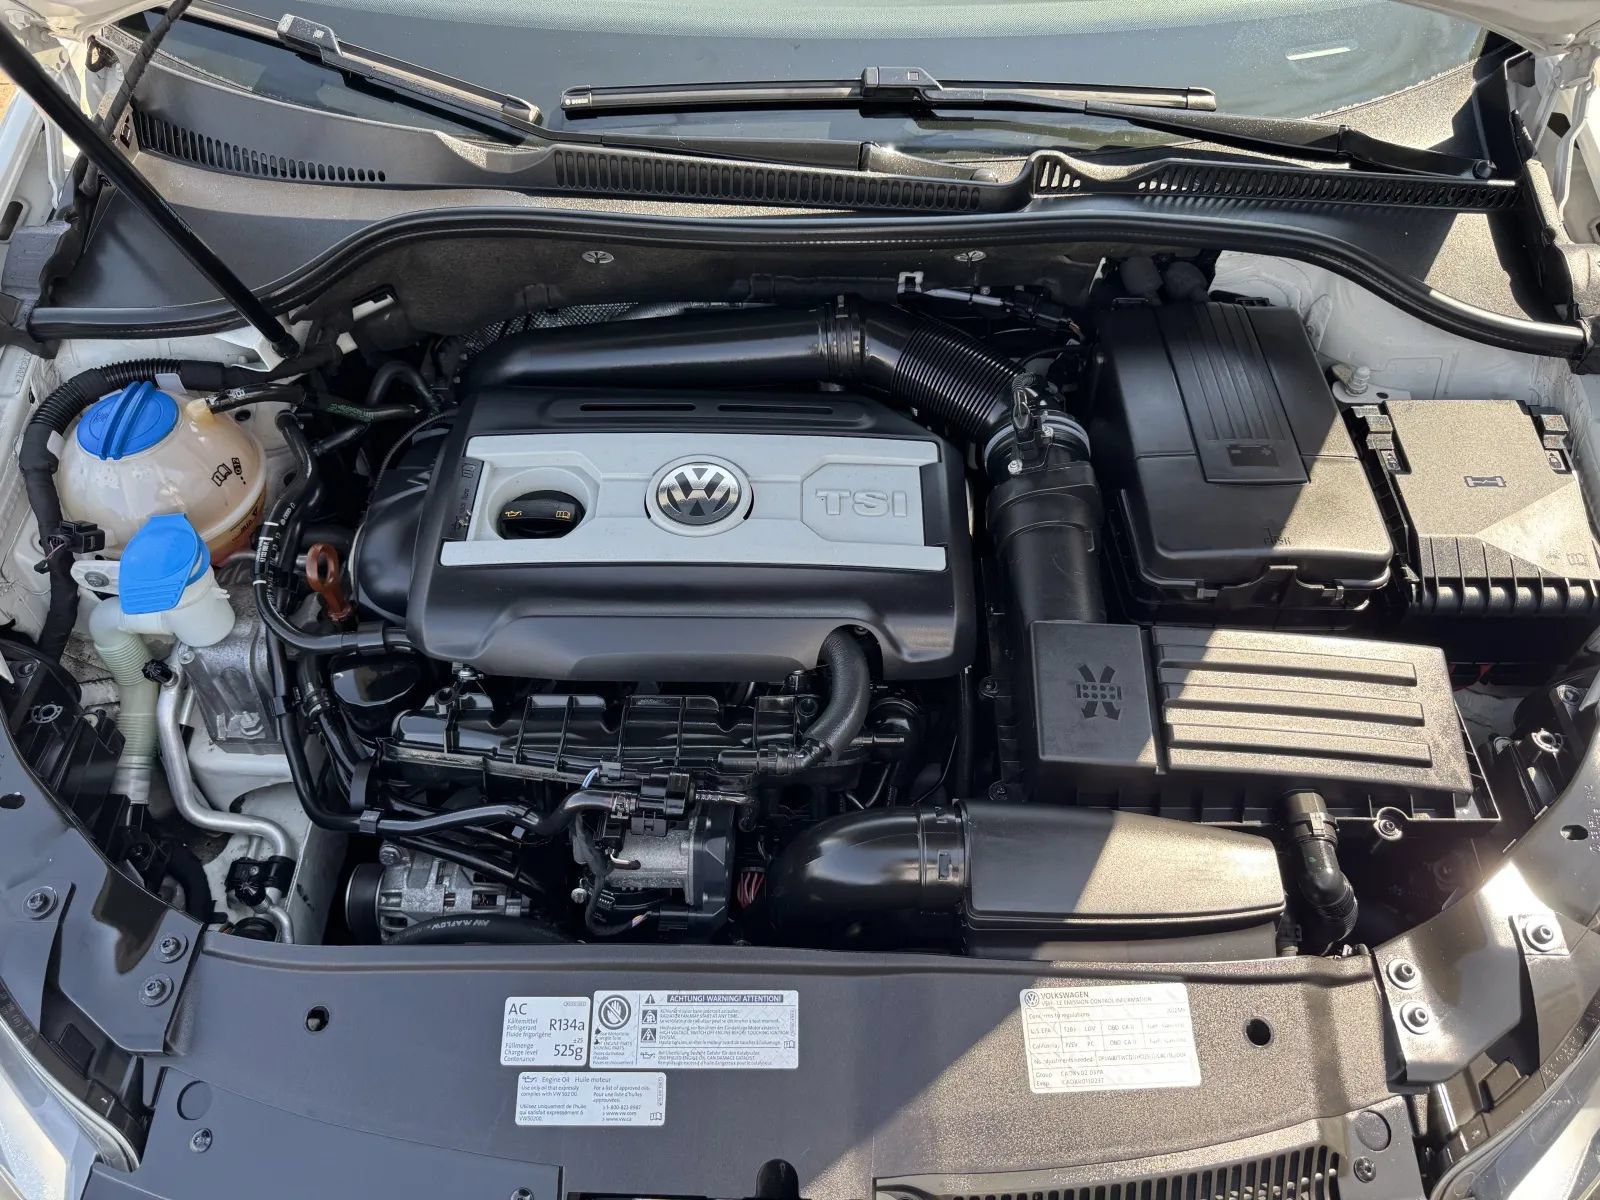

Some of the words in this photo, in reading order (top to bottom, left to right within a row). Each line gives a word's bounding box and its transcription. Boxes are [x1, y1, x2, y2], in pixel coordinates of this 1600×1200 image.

[815, 488, 908, 519] TSI
[1040, 991, 1089, 999] VOLKSWAGEN
[508, 1003, 528, 1015] AC
[549, 1018, 585, 1031] R134a
[553, 1044, 584, 1060] 525g
[541, 1076, 560, 1084] Engine
